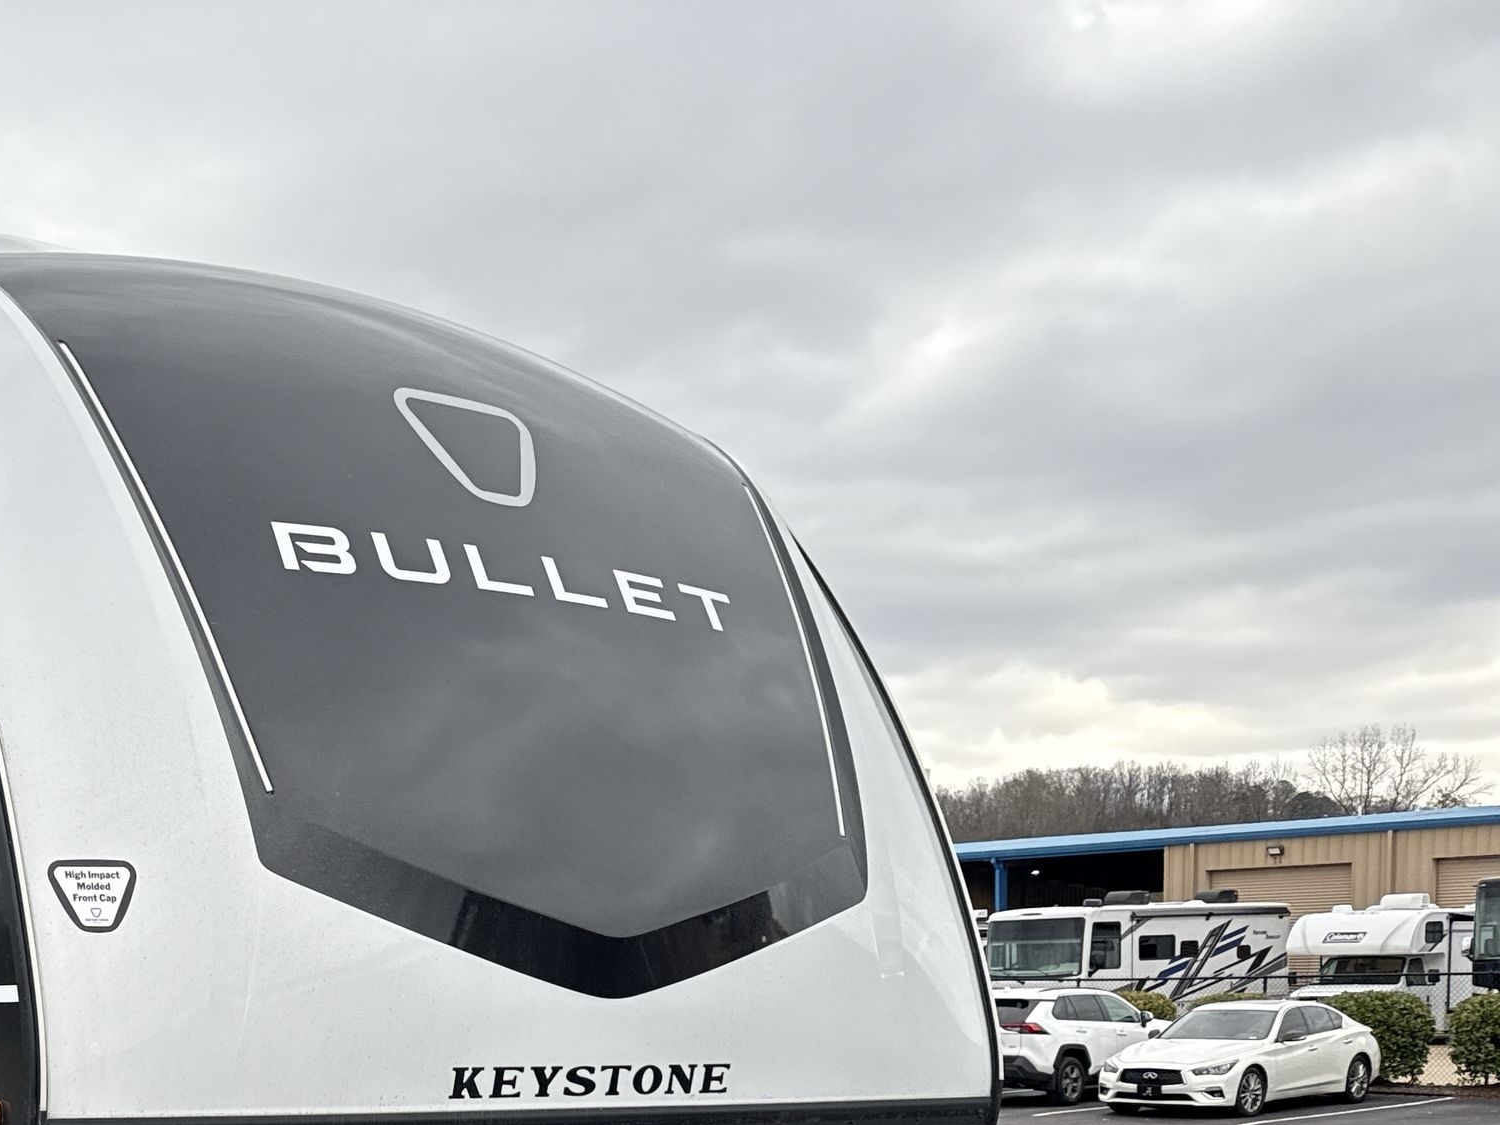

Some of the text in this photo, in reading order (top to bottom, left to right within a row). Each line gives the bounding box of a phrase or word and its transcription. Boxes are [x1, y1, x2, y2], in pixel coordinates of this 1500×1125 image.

[270, 521, 730, 632] BULLET
[64, 870, 120, 880] High Impact
[76, 882, 111, 891] Molded
[72, 893, 117, 904] Front Cap
[449, 1063, 731, 1099] KEYSTONE
